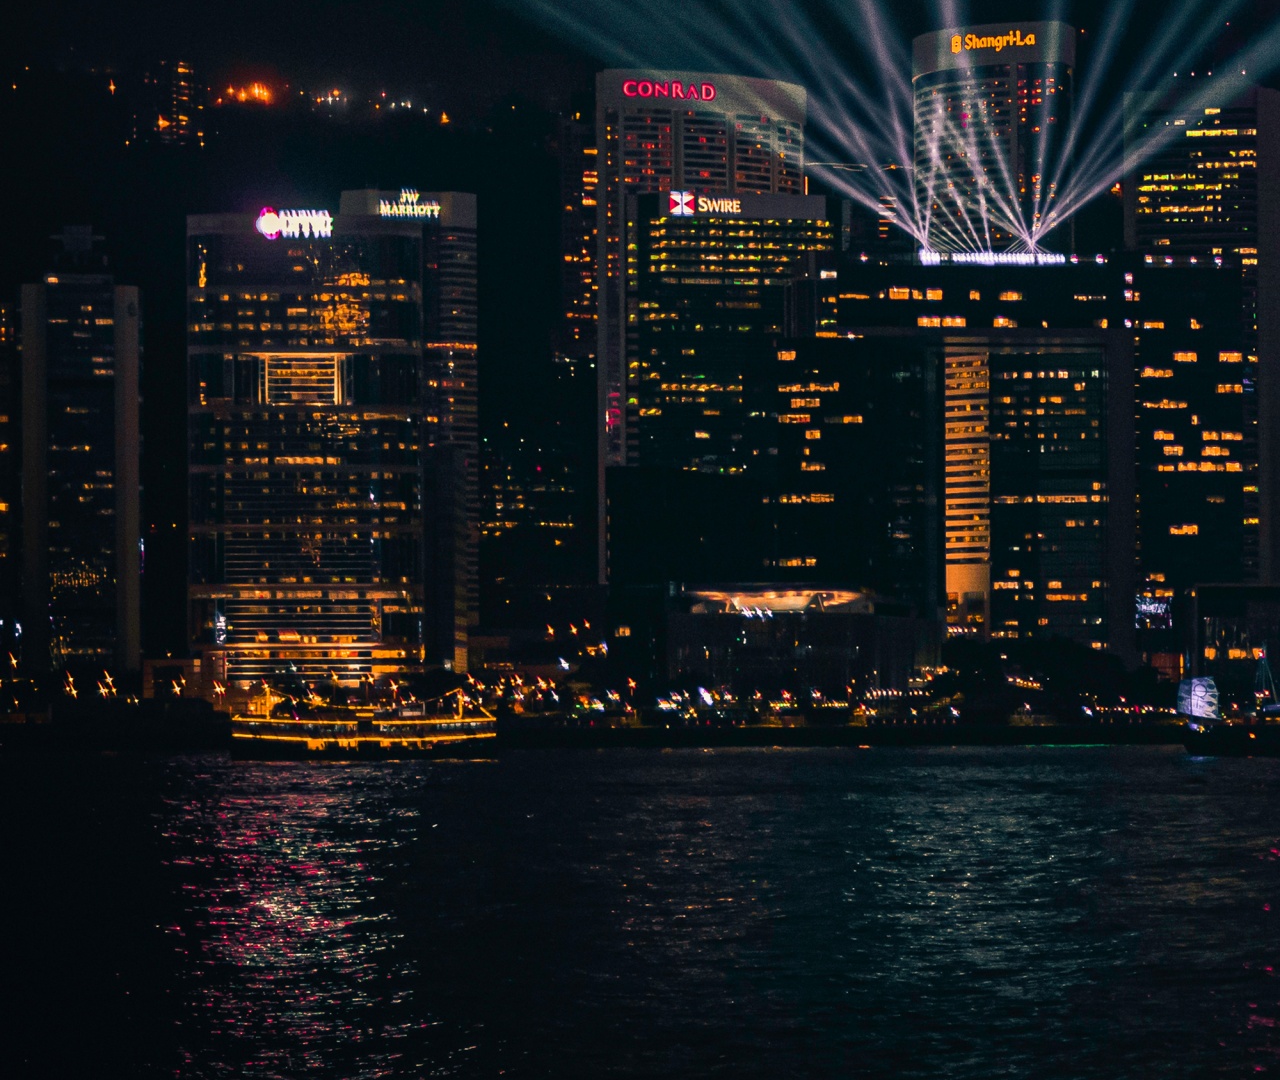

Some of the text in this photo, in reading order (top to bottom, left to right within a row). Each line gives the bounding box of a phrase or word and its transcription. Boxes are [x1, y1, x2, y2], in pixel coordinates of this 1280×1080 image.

[964, 30, 1035, 52] Shangri-La
[622, 79, 717, 101] CONRAD
[379, 200, 441, 218] MARRIOTT
